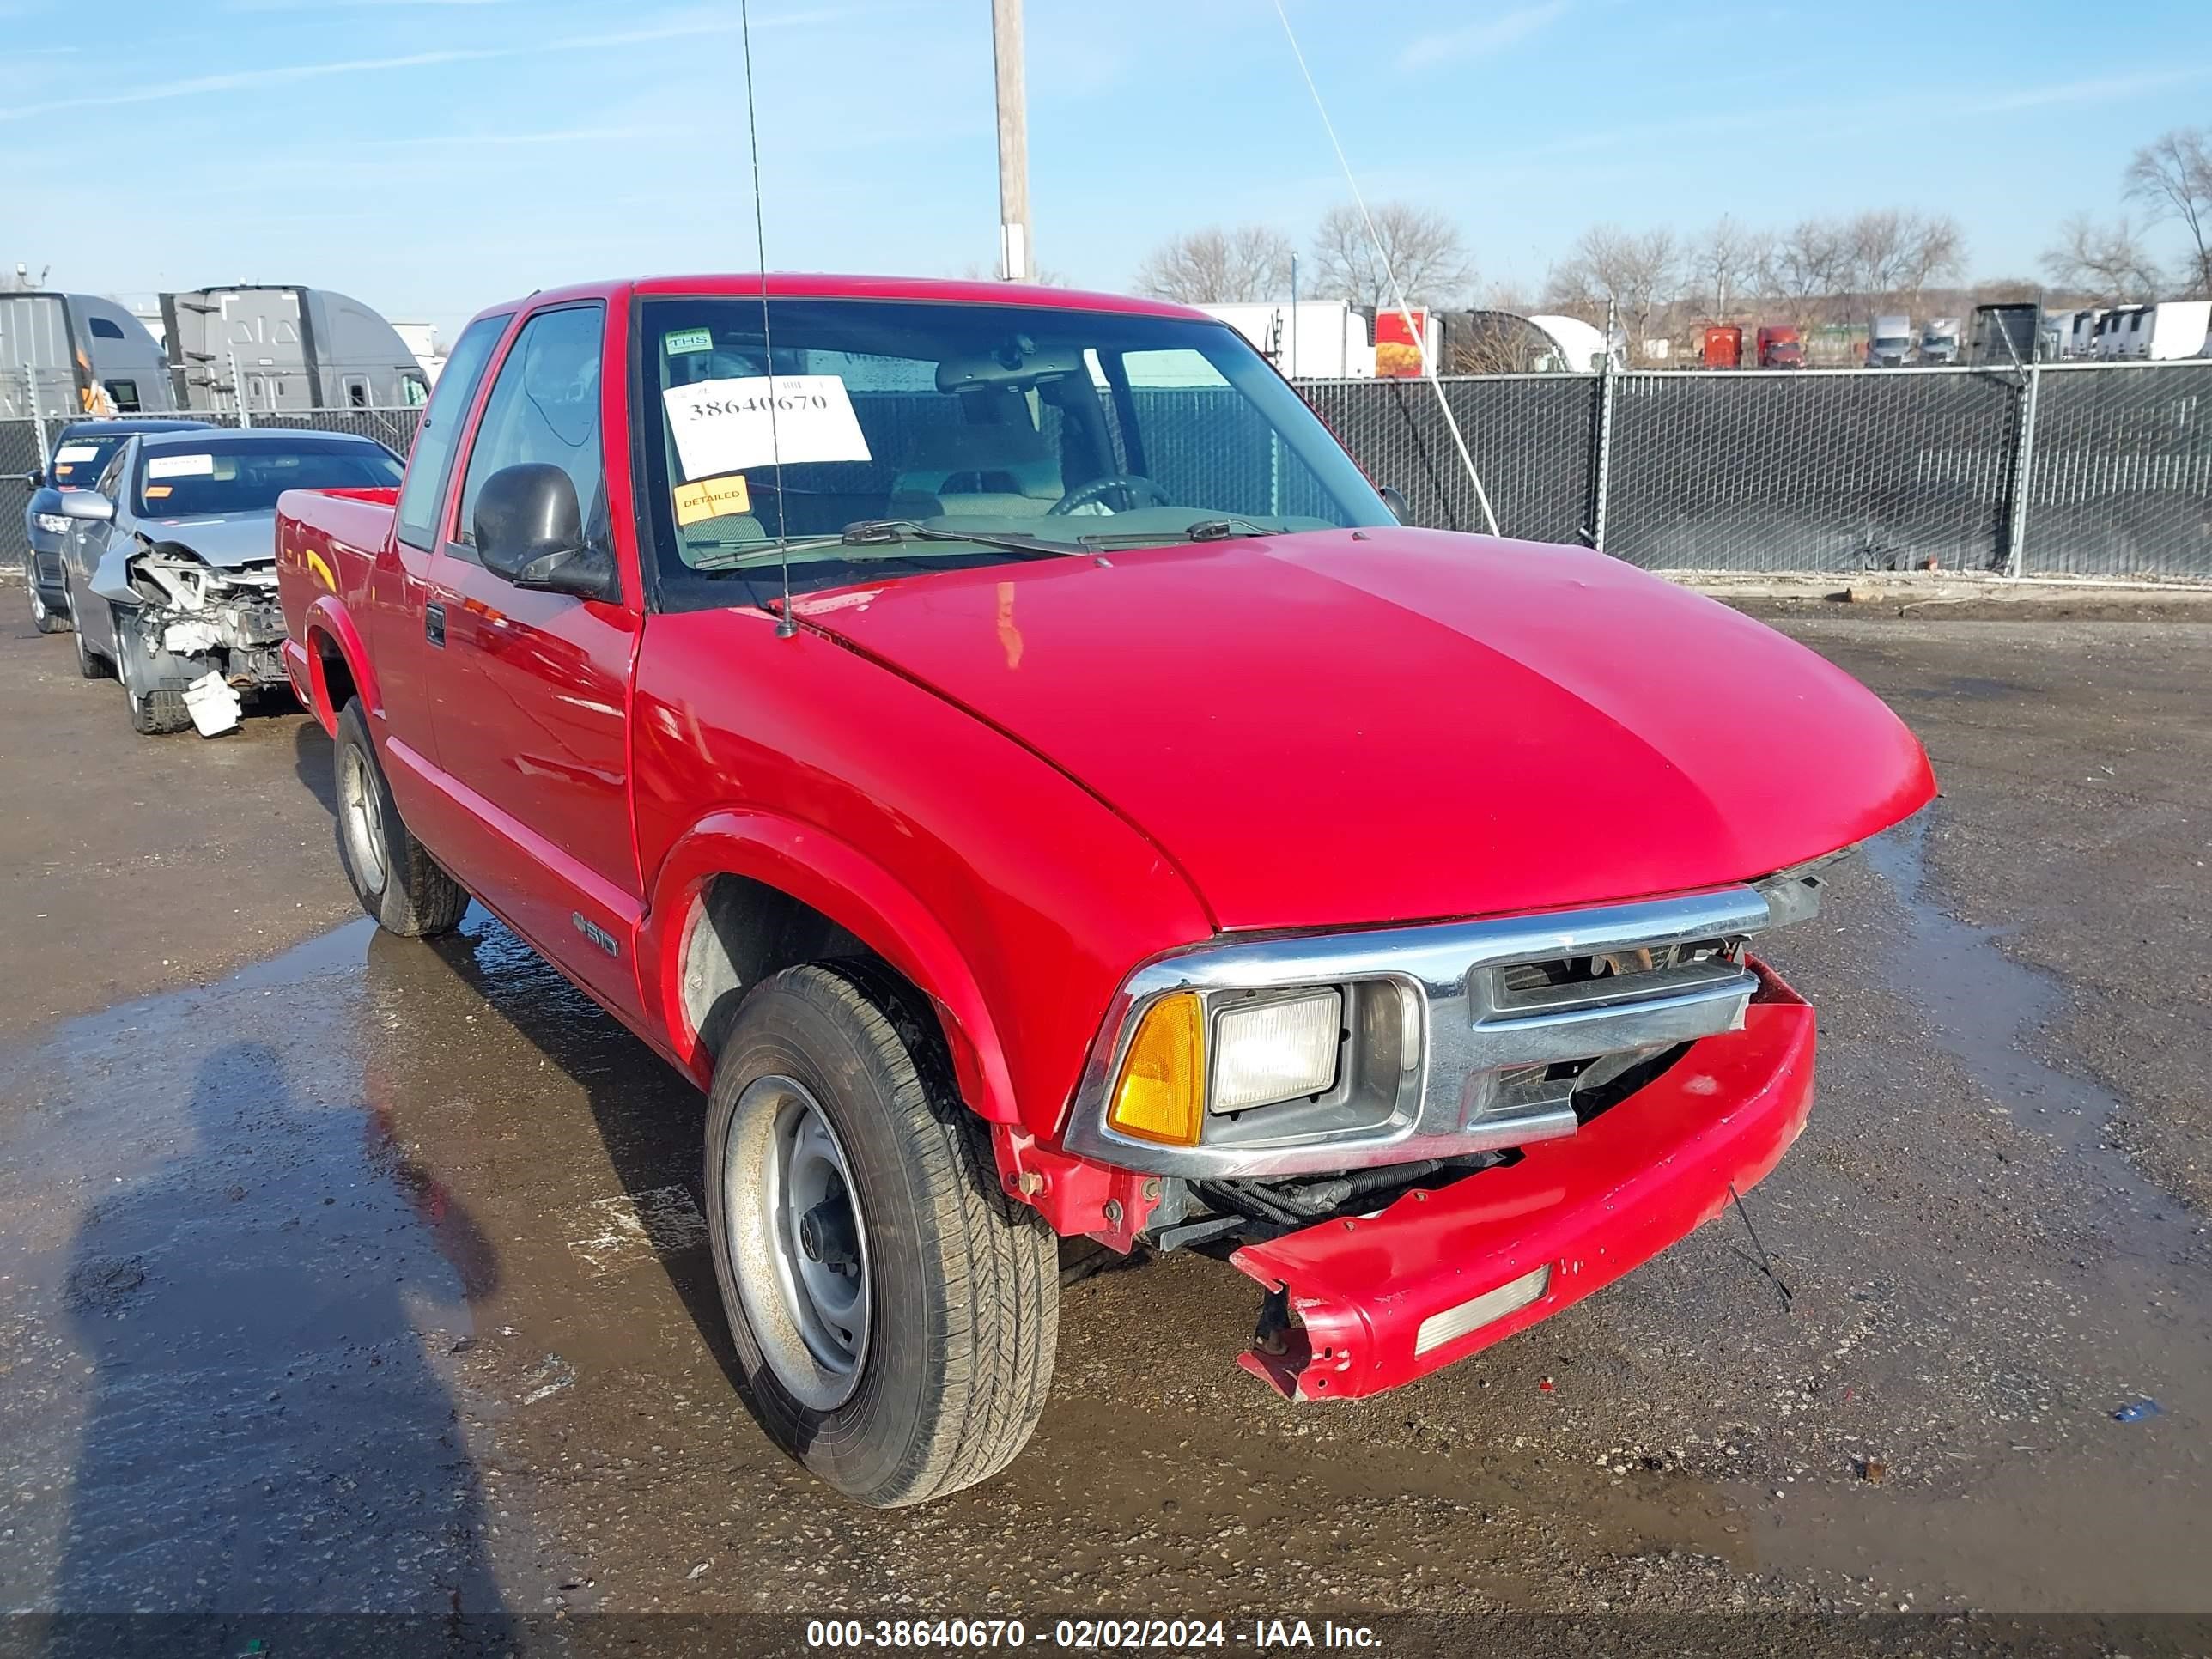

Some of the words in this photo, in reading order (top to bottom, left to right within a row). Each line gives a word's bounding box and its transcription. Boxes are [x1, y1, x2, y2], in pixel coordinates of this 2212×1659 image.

[672, 336, 708, 347] THS
[690, 395, 827, 421] 38640670
[684, 490, 740, 508] DETAILED
